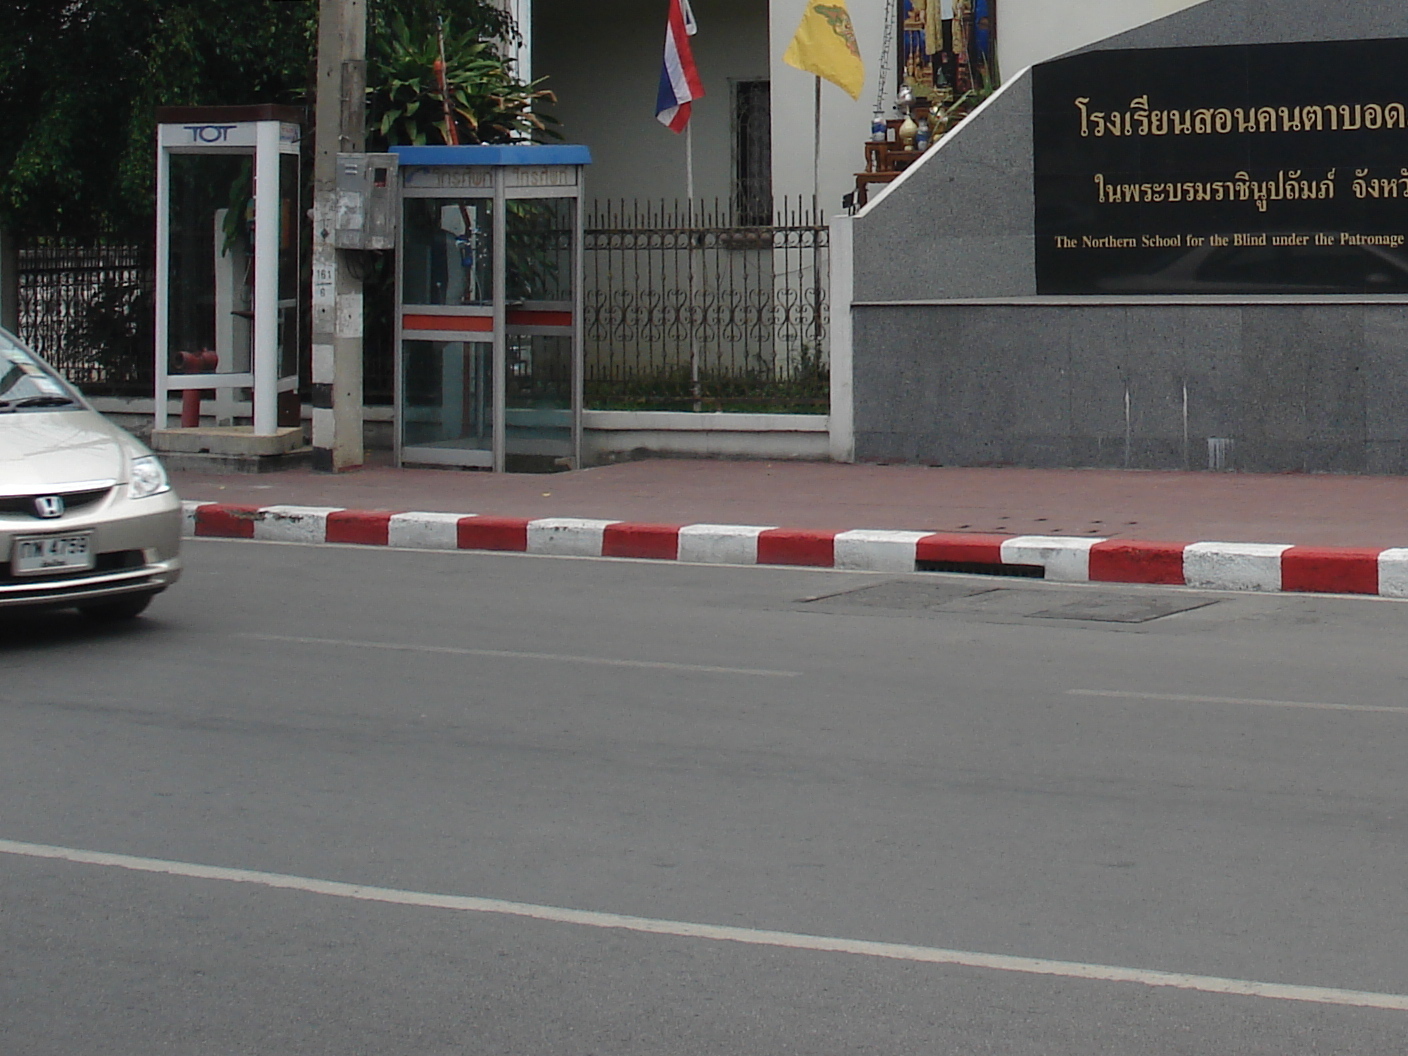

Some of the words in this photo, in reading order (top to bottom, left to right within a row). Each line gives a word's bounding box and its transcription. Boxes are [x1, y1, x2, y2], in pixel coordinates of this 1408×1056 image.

[183, 125, 238, 143] TOT
[1094, 167, 1336, 212] ในพระบรมราชินูปถัมภ์
[1055, 236, 1078, 248] The
[1082, 235, 1137, 248] Northern
[1142, 235, 1181, 248] School
[1186, 234, 1205, 247] for
[1210, 234, 1229, 247] the
[1233, 233, 1267, 246] Blind
[1272, 233, 1310, 246] under
[1314, 232, 1335, 246] the
[1340, 232, 1405, 248] Patronage
